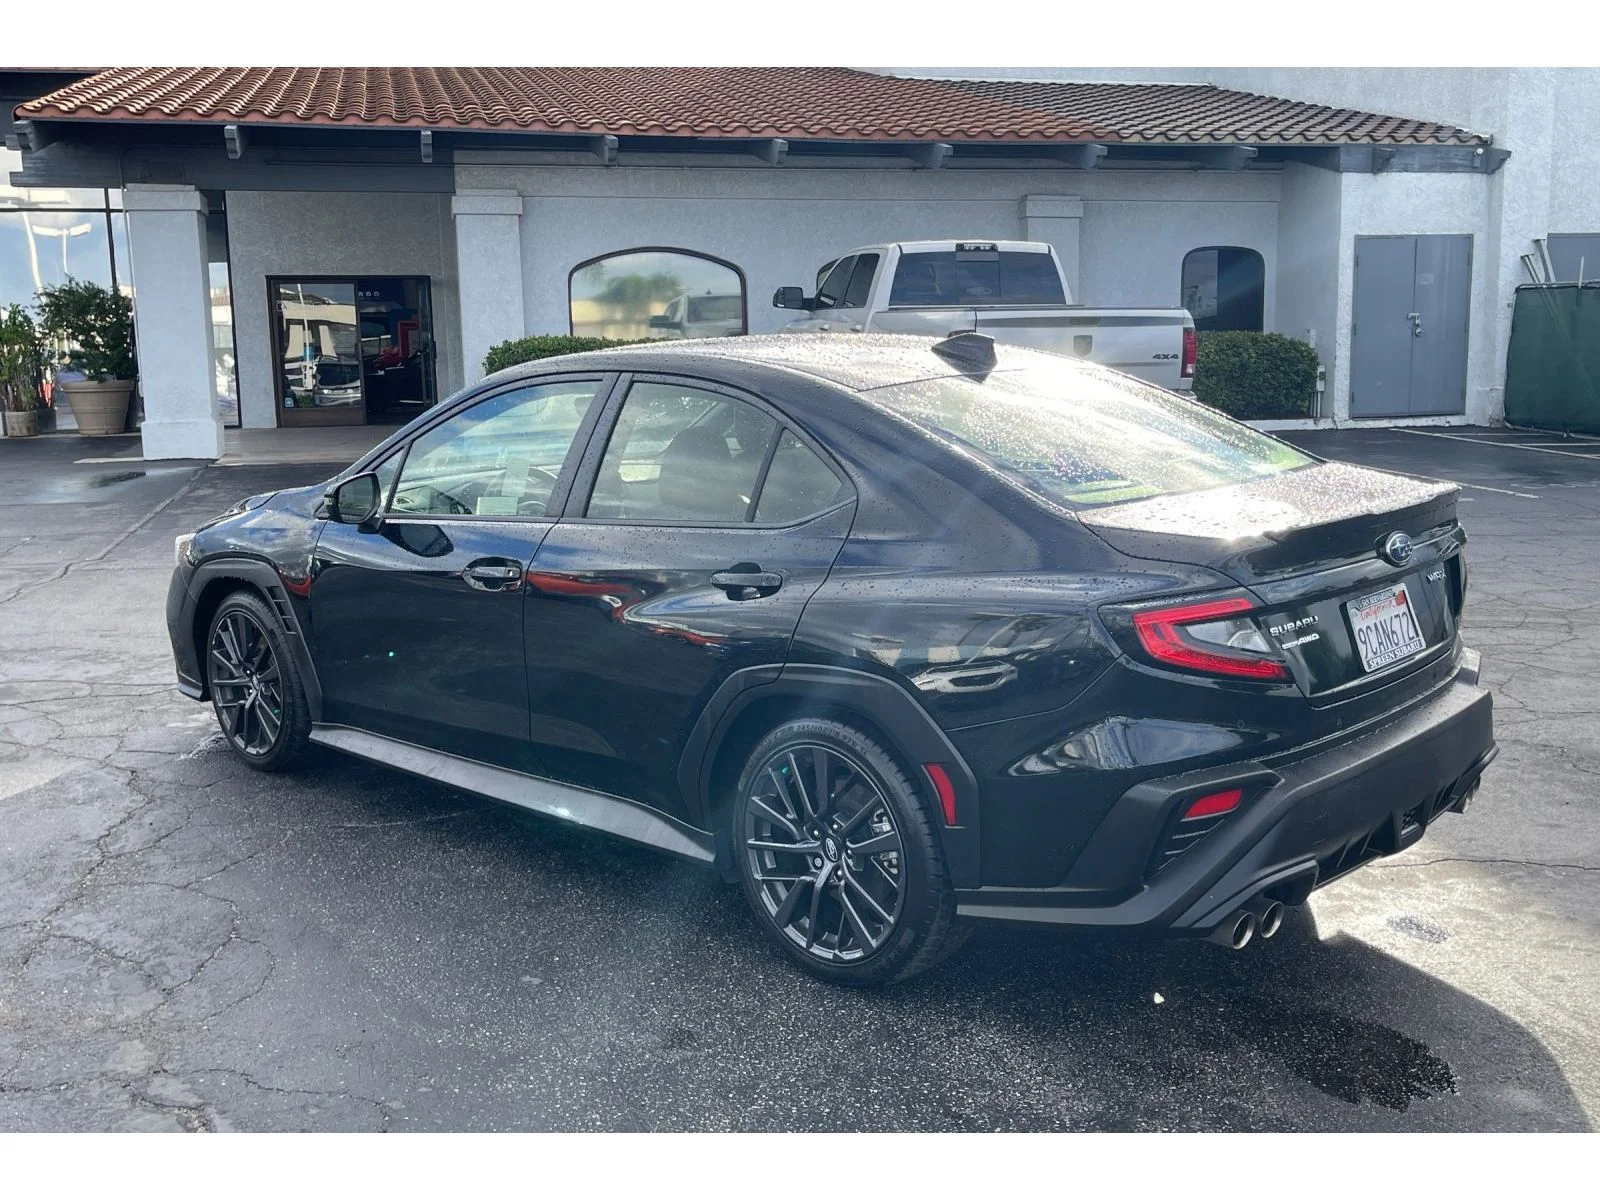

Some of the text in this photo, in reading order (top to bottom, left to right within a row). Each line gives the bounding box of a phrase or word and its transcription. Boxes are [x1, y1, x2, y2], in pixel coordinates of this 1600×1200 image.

[1426, 568, 1447, 583] WRX
[1269, 615, 1319, 637] SUBARU
[1357, 611, 1415, 659] 9CAN672
[1369, 640, 1420, 669] SPREEN SUBARU
